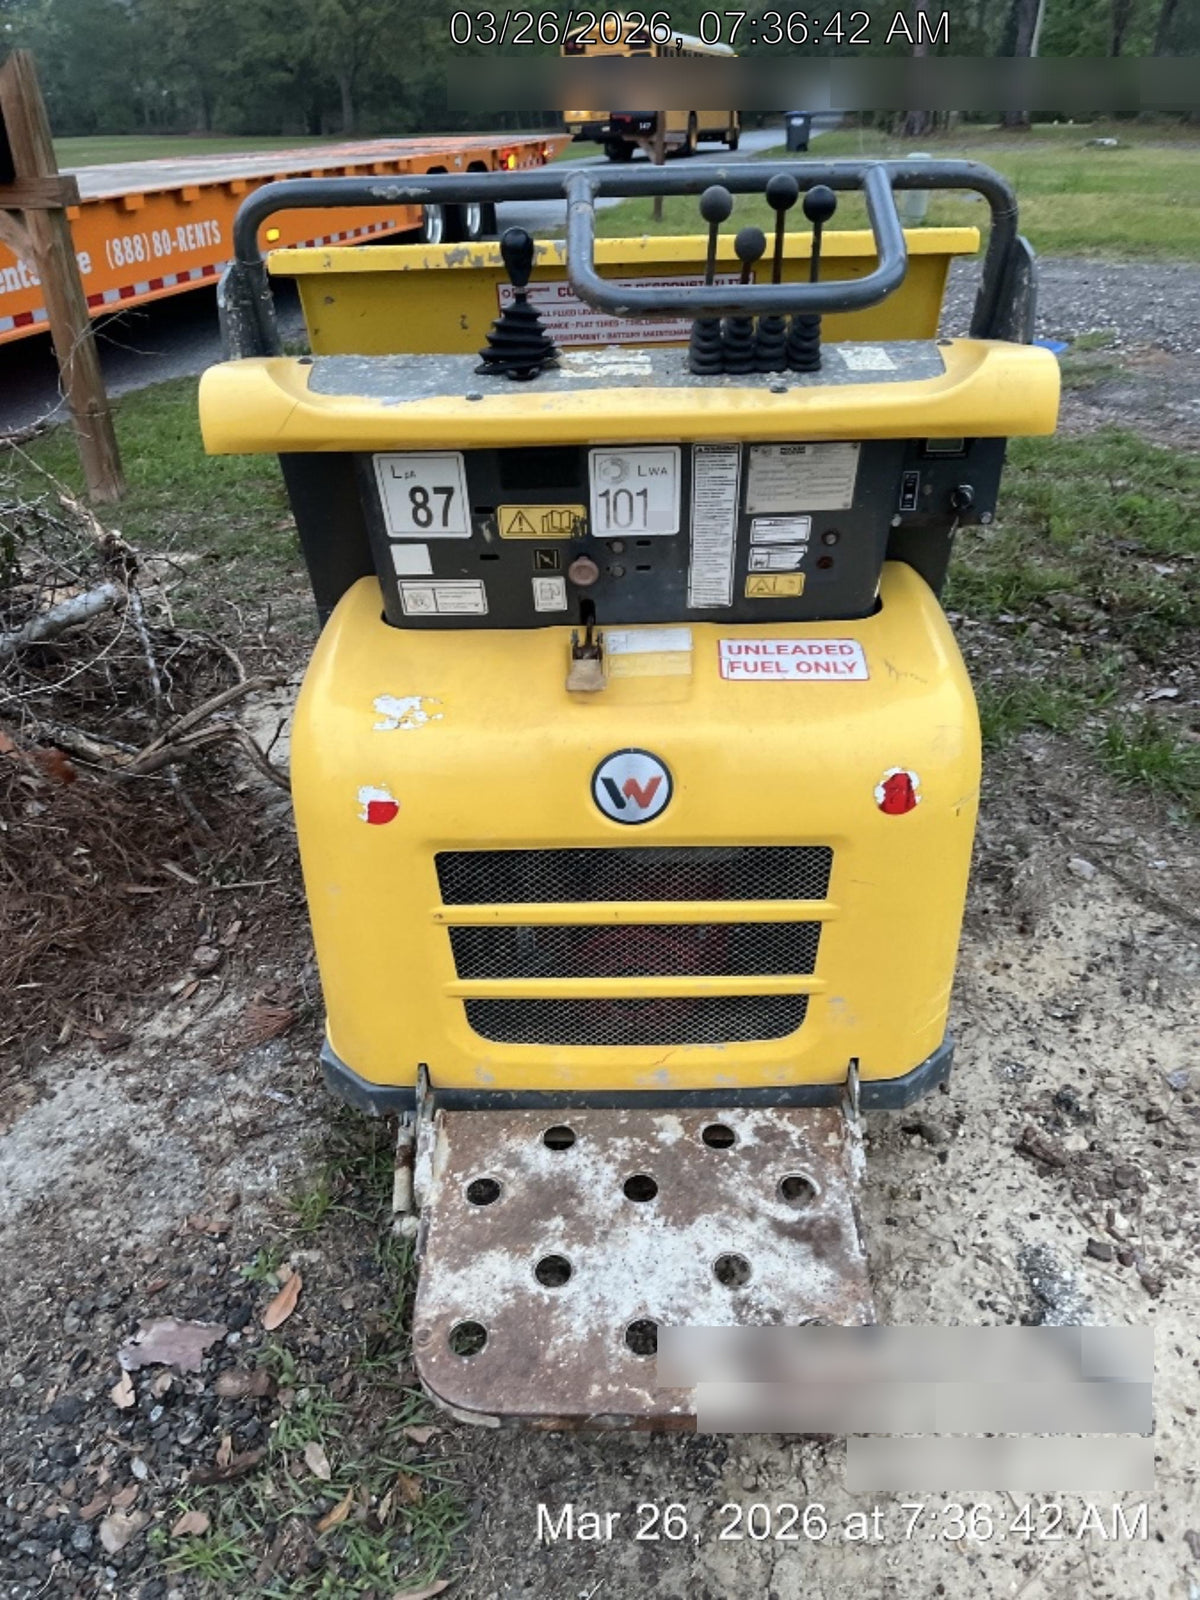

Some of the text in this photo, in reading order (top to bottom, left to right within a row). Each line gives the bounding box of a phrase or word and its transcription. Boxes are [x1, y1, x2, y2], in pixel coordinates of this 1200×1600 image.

[105, 232, 151, 270] (888)
[152, 220, 222, 257] 80-RENTS
[408, 485, 454, 529] 87
[598, 487, 648, 529] 101
[727, 643, 855, 656] UNLEADED
[728, 660, 858, 674] FUEL ONLY
